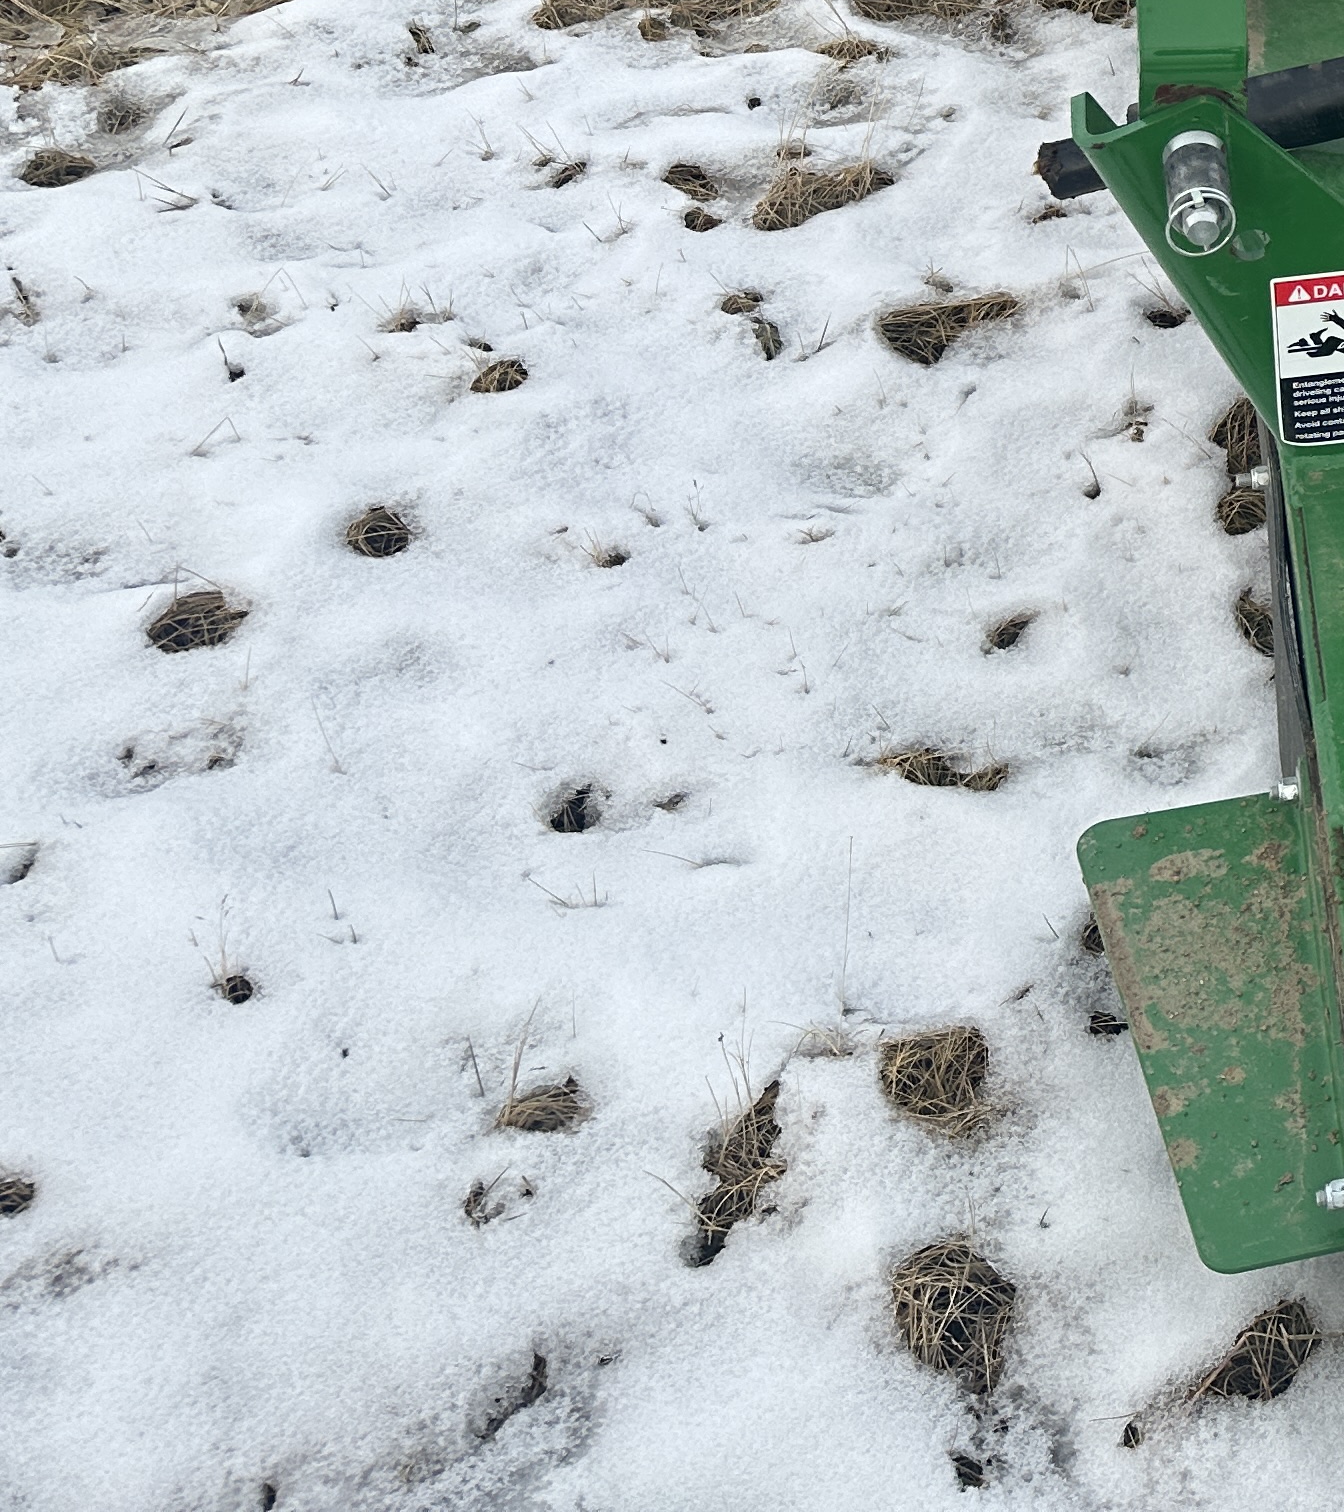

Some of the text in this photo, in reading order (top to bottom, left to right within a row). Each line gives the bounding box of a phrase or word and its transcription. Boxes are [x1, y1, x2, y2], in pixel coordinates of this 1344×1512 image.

[1293, 396, 1327, 406] serious
[1294, 408, 1317, 419] Keep
[1320, 407, 1331, 416] all
[1294, 419, 1321, 429] Avoid
[1295, 431, 1331, 440] rotating
